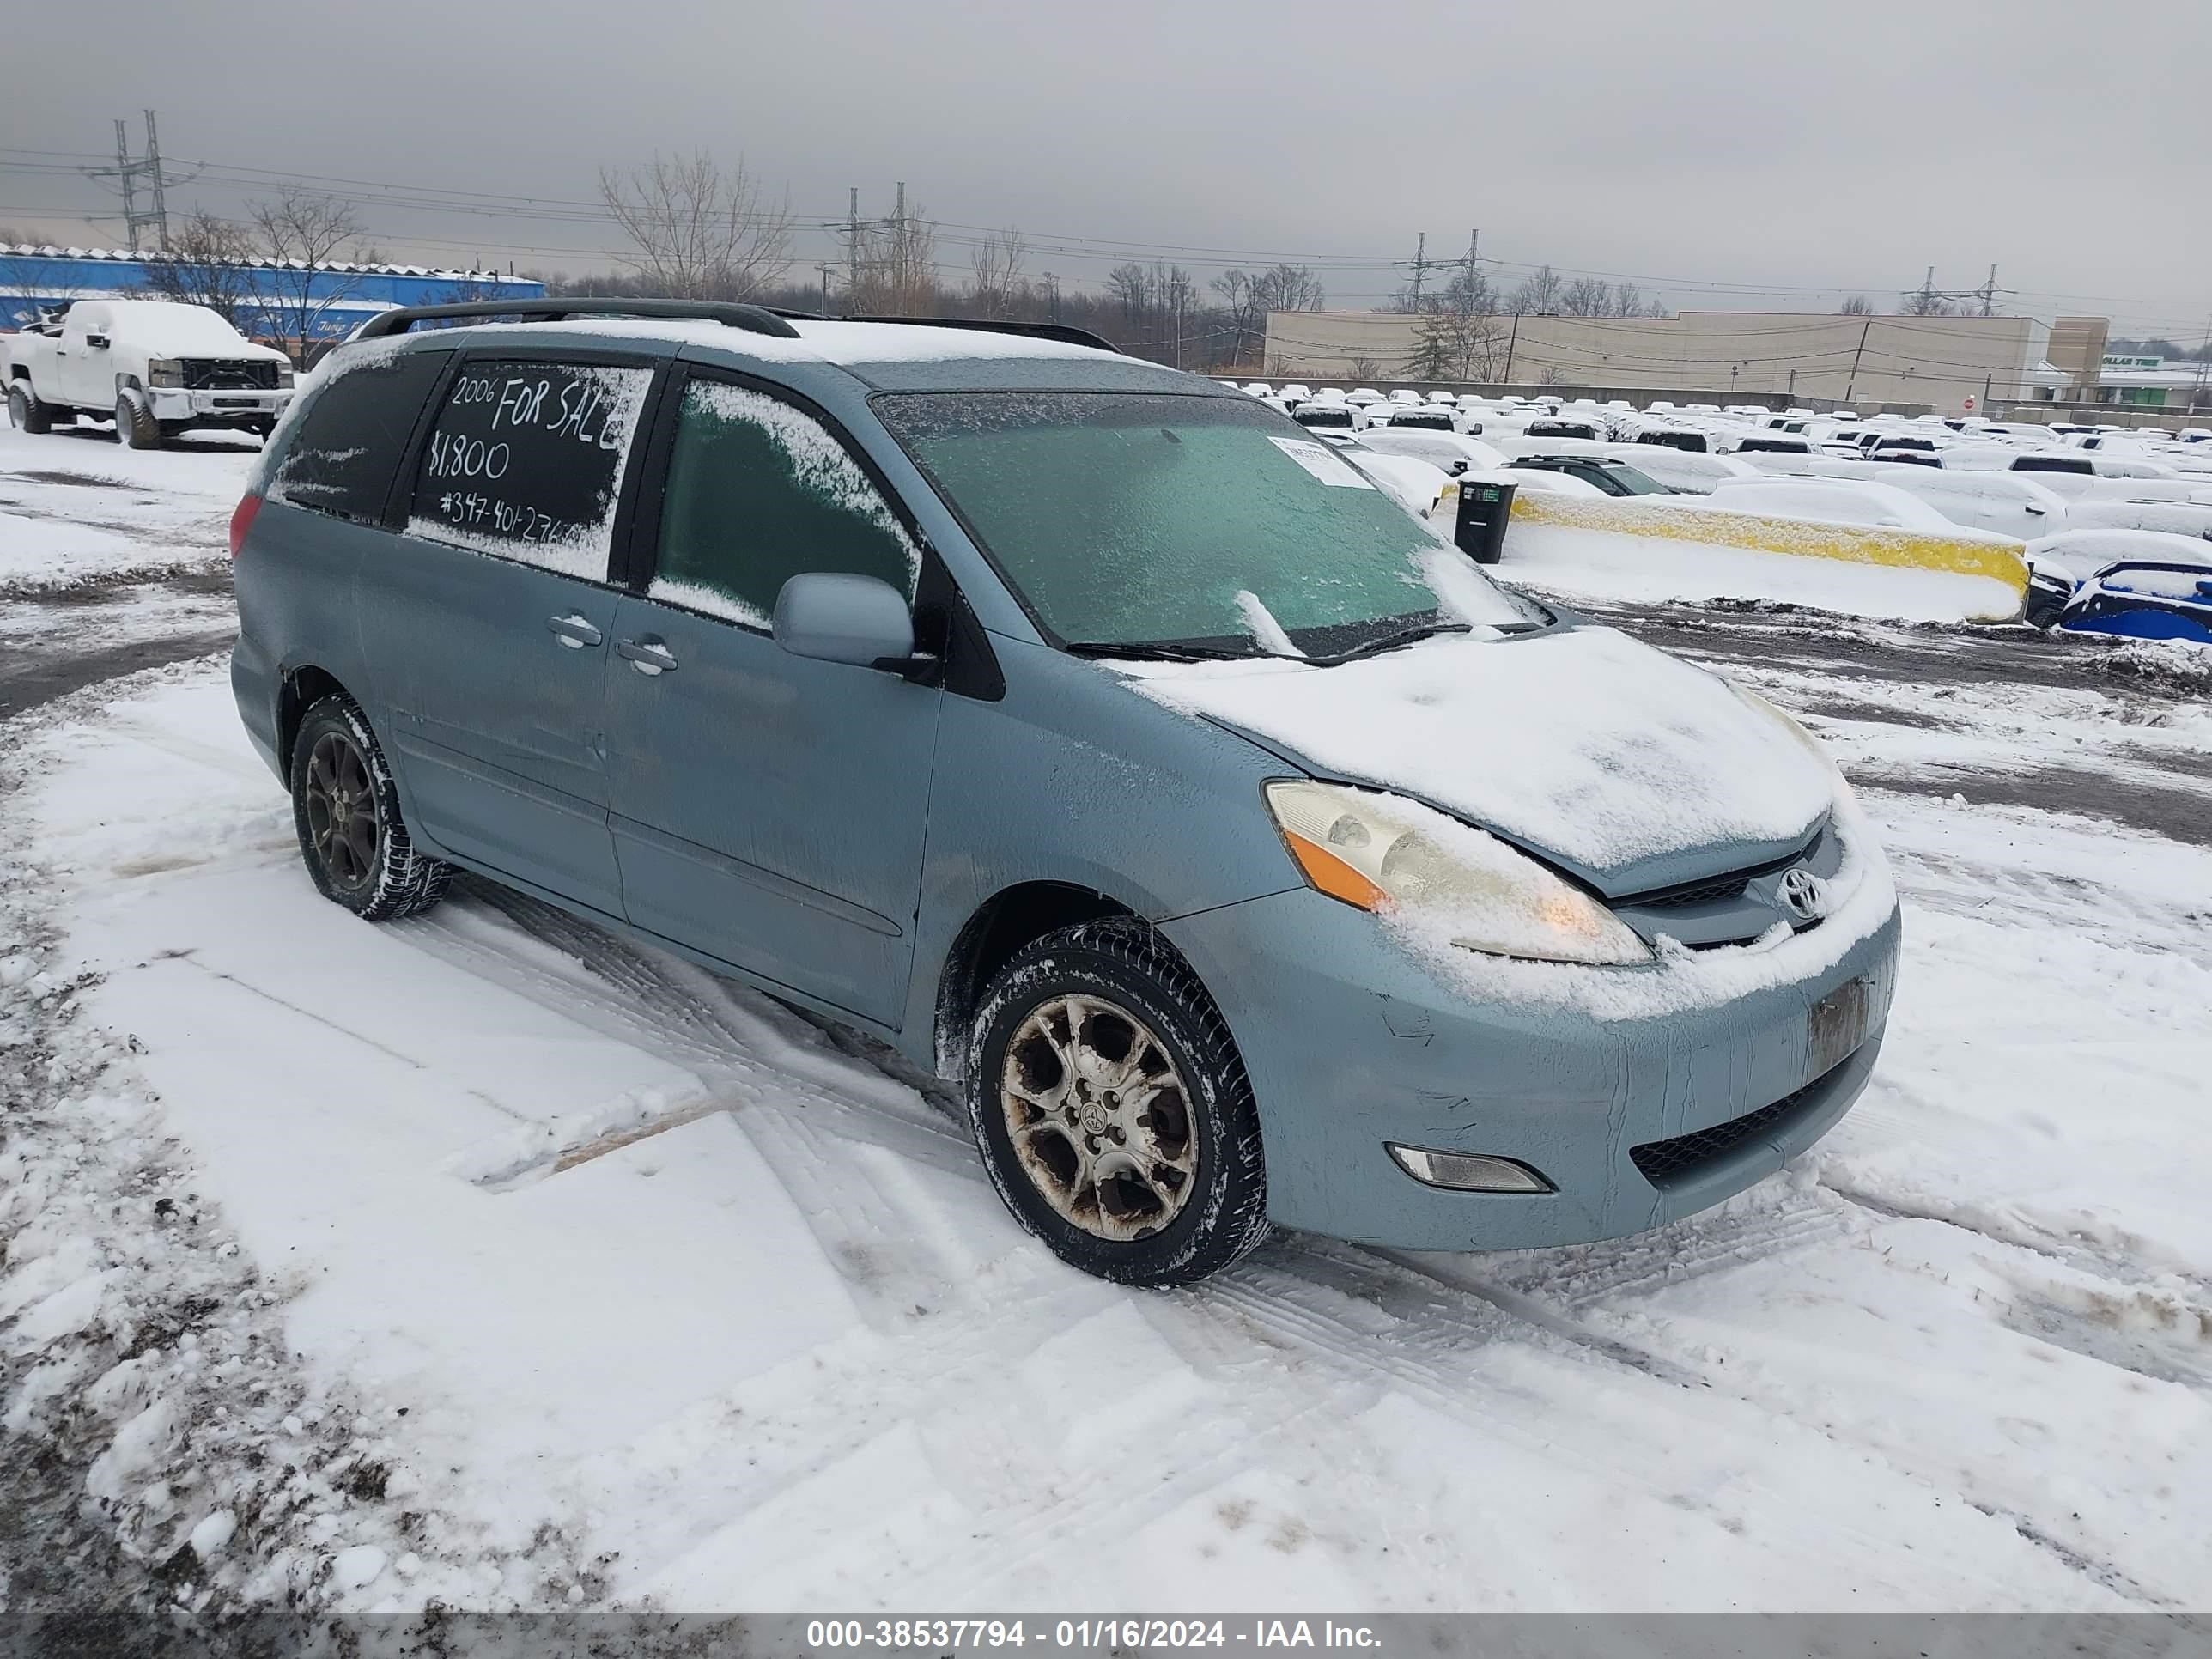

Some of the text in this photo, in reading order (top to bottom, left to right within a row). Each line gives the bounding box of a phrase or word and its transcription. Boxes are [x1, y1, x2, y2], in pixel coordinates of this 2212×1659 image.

[452, 376, 623, 450] 2006 FOR SALE
[428, 429, 510, 479] $1,800
